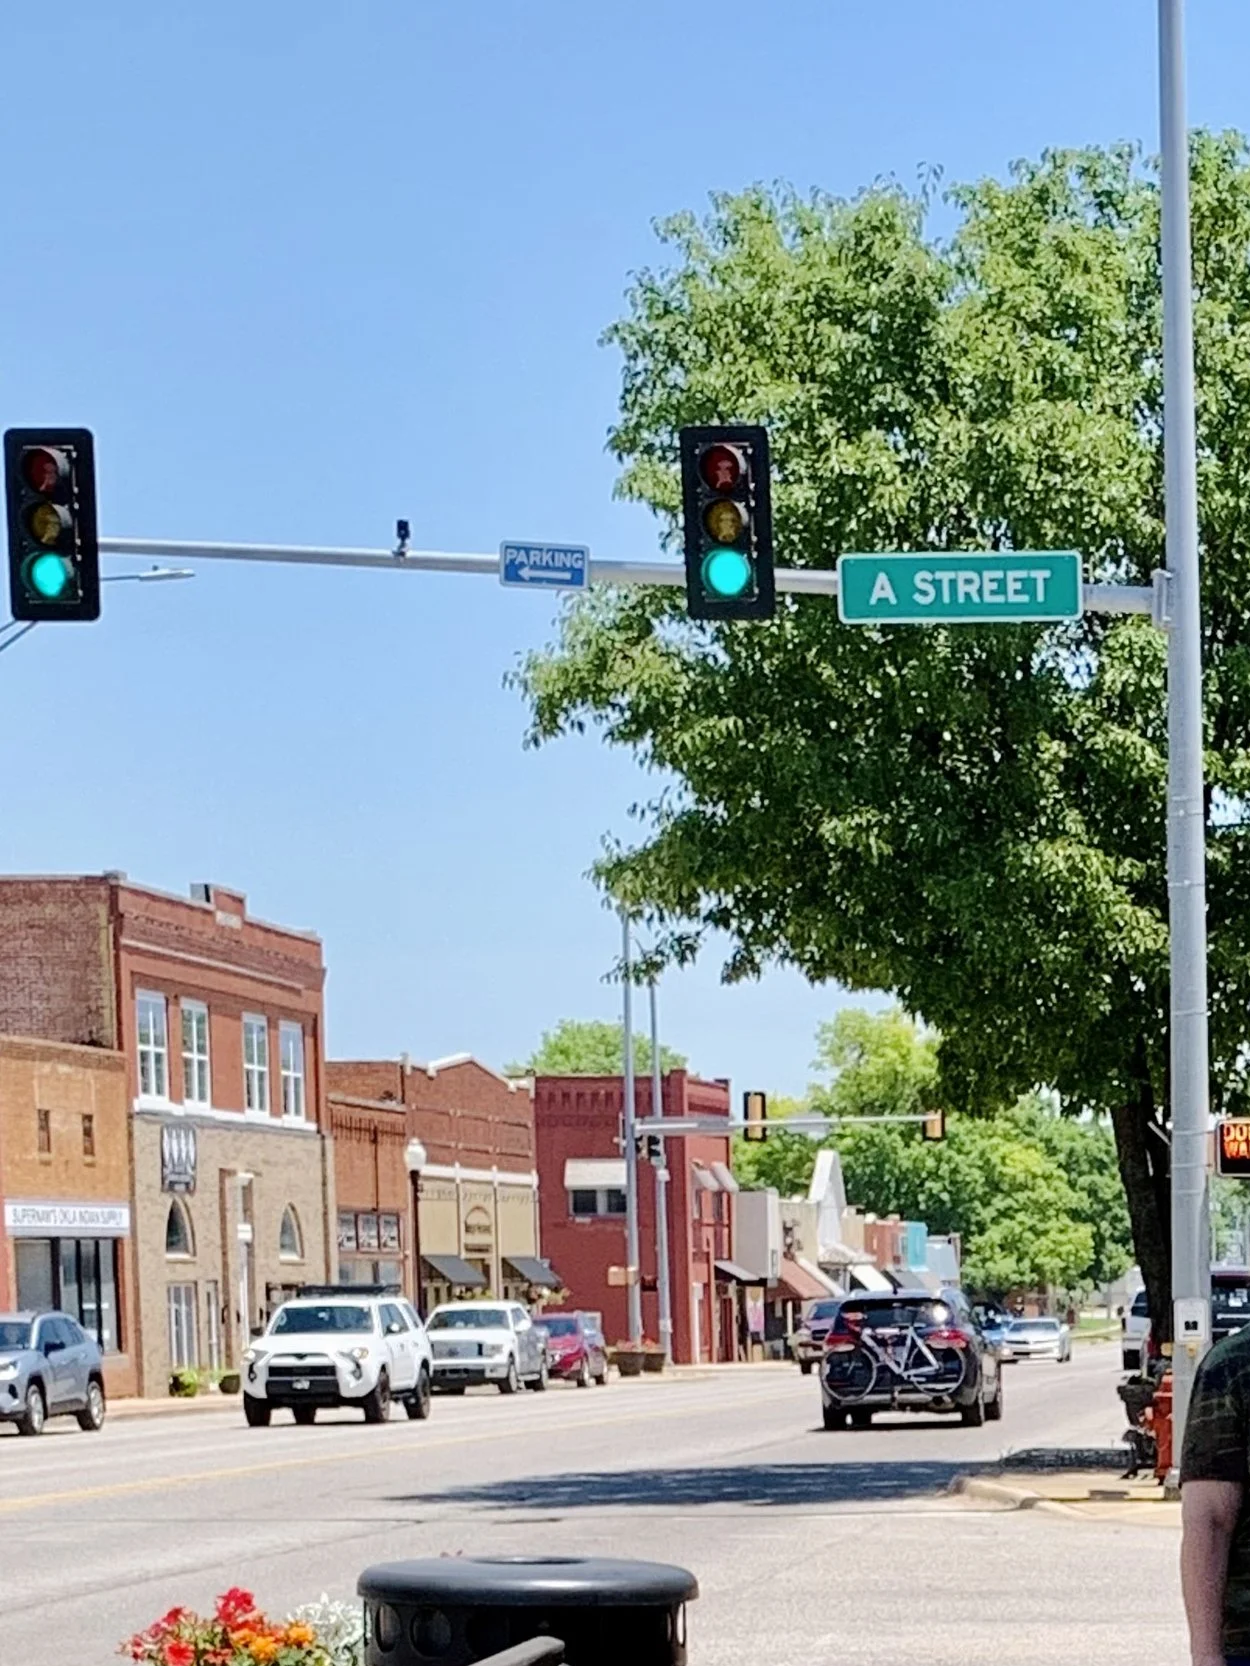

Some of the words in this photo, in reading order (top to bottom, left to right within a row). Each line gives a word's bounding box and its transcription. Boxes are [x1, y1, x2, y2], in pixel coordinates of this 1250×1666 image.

[505, 548, 584, 569] PARKING
[869, 571, 897, 606] A
[912, 569, 1051, 606] STREET
